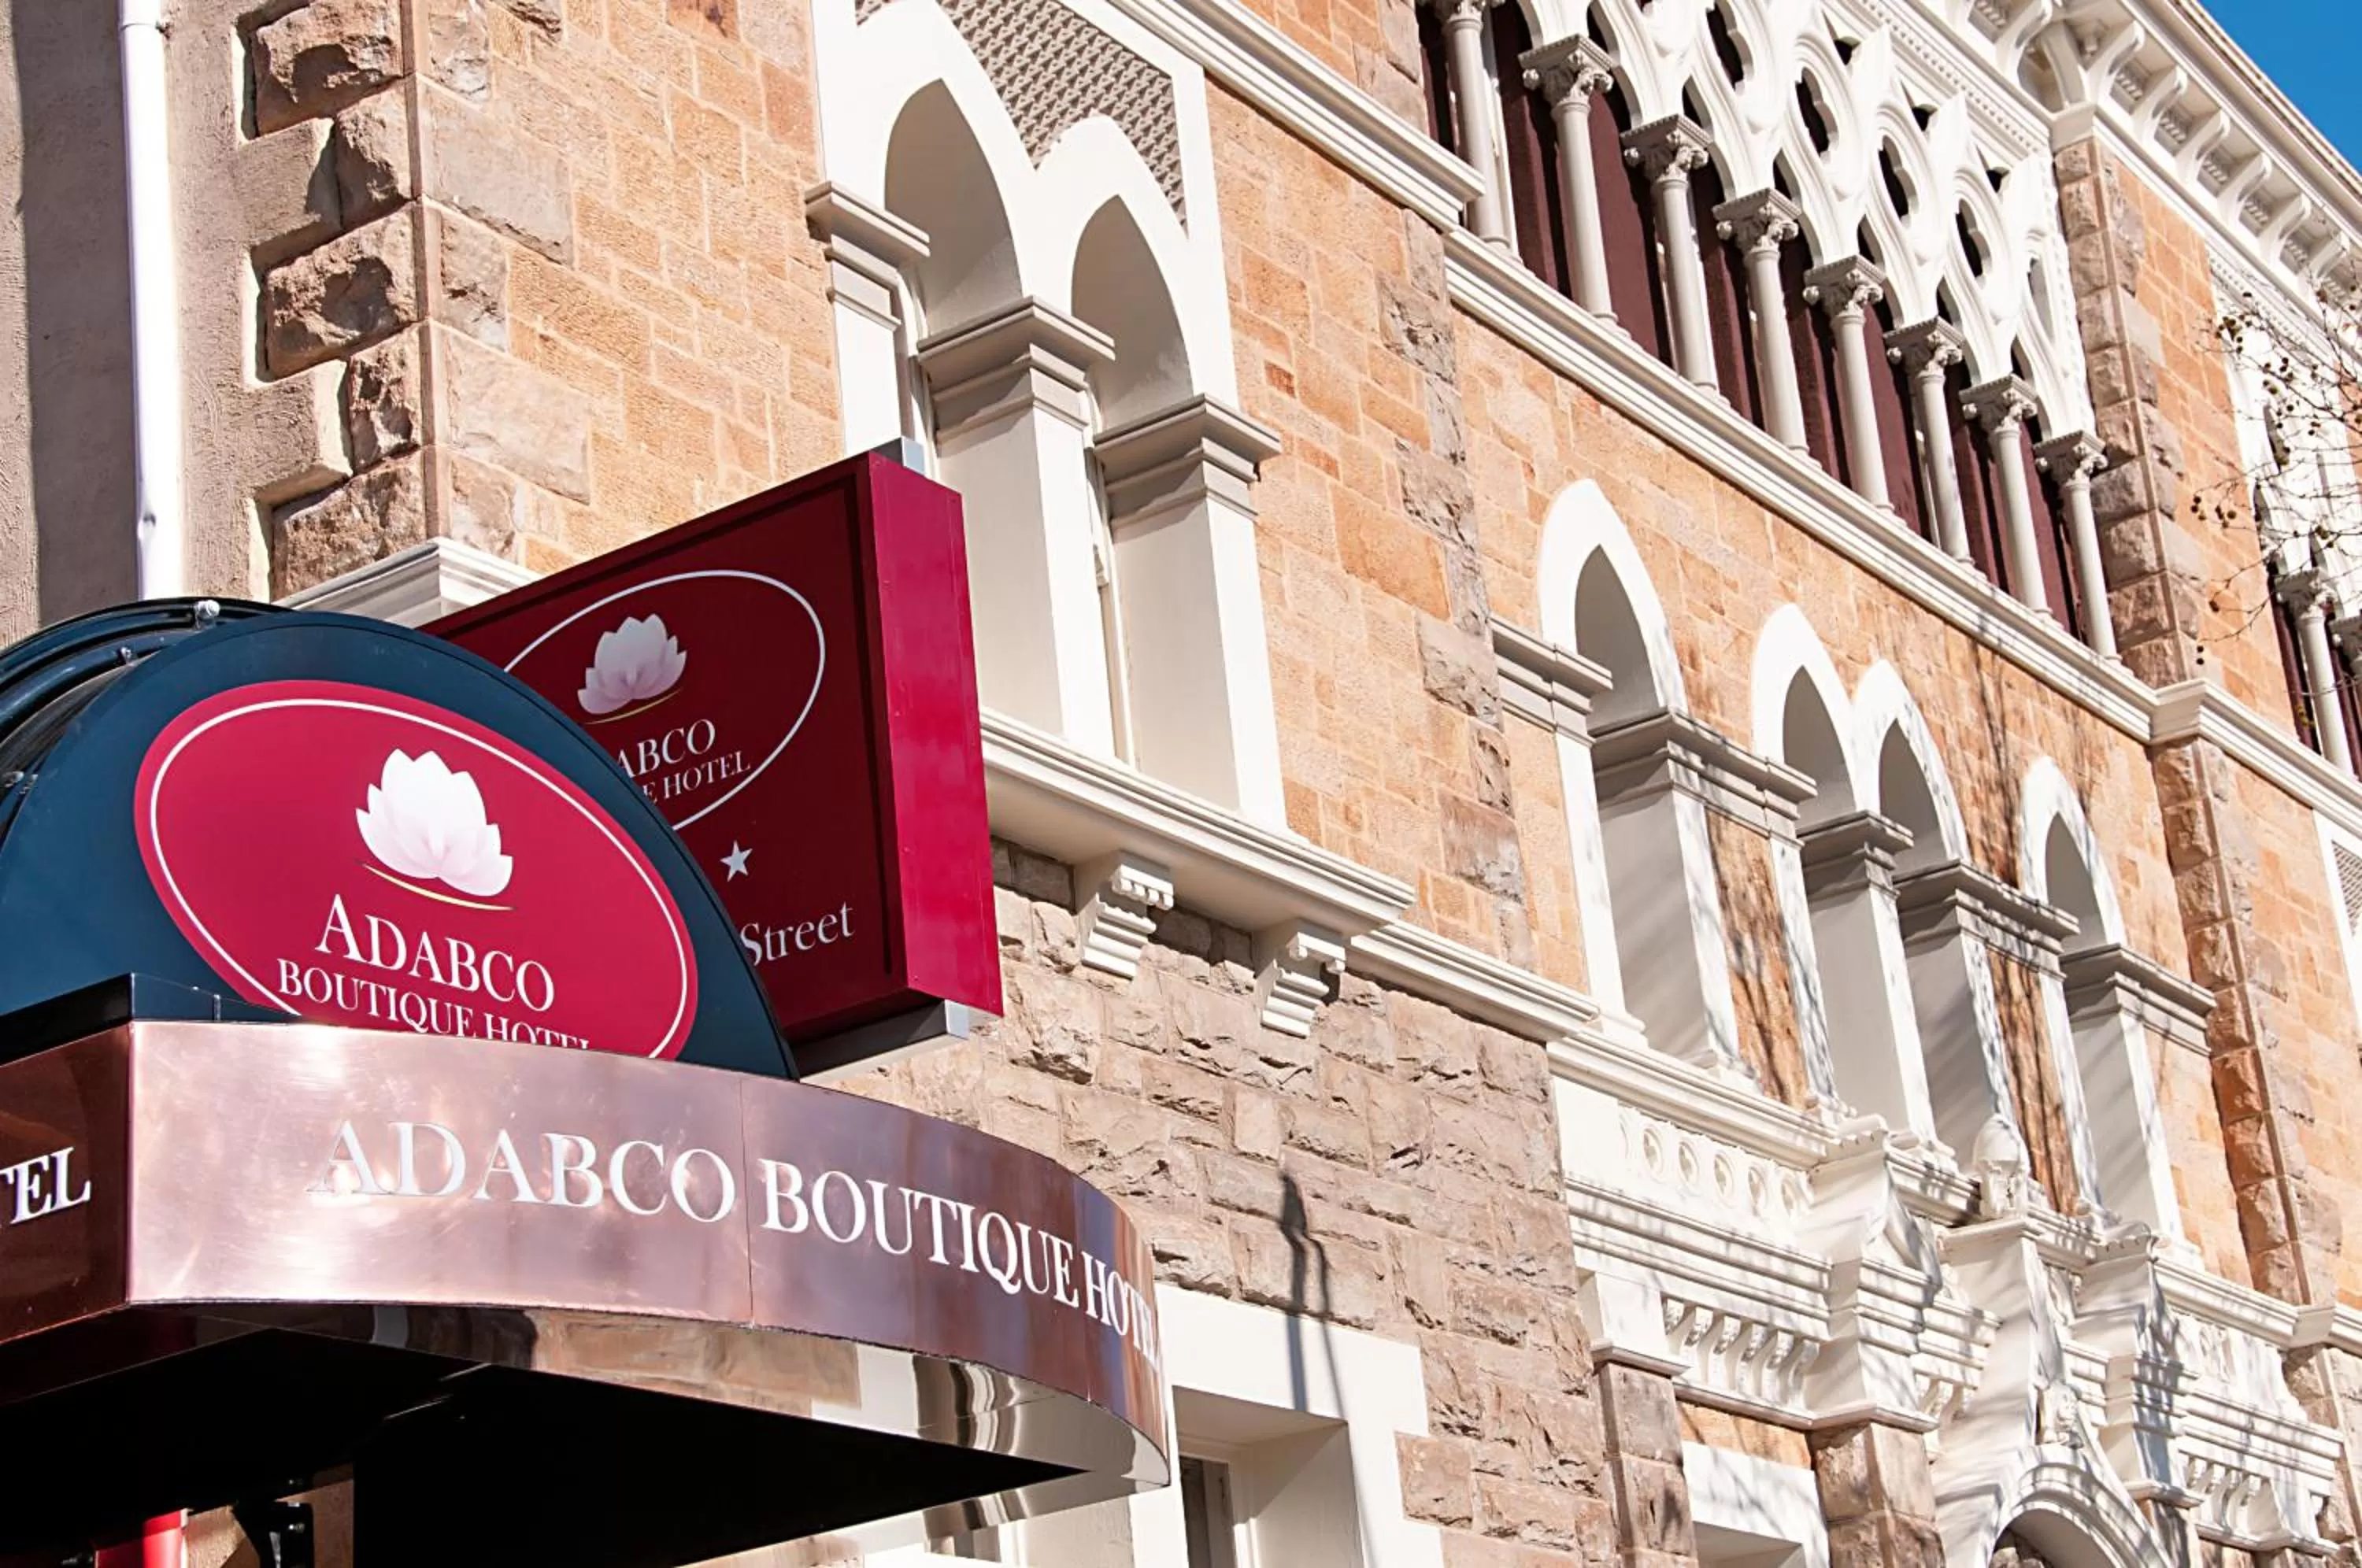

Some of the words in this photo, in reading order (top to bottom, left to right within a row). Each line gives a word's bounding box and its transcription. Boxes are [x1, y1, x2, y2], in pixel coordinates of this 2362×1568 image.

[663, 750, 751, 800] HOTEL
[315, 893, 554, 1011] ADABCO
[740, 900, 855, 967] Street
[277, 958, 476, 1038] BOUTIQUE
[483, 1012, 590, 1049] HOT
[305, 1119, 736, 1222] ADABCO
[760, 1159, 1079, 1309] BOUTIQUE
